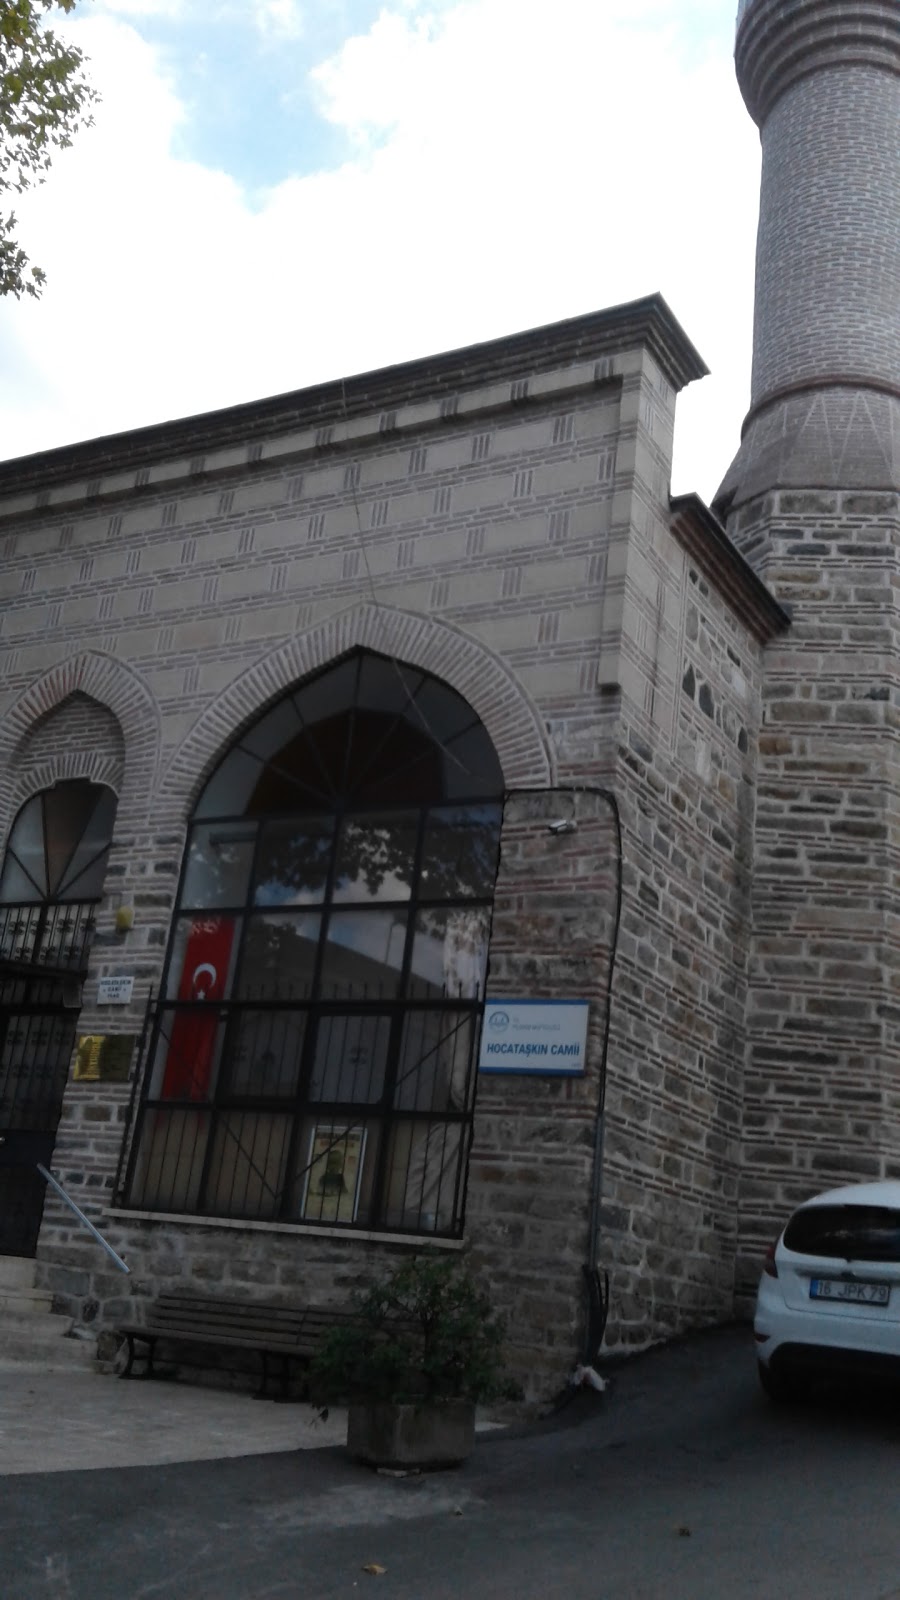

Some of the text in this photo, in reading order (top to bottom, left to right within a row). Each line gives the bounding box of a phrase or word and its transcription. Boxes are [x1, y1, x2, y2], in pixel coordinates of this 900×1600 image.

[487, 1042, 580, 1058] HOCATAŞKIN CAMİİ
[819, 1280, 888, 1301] 16 JPK 79
